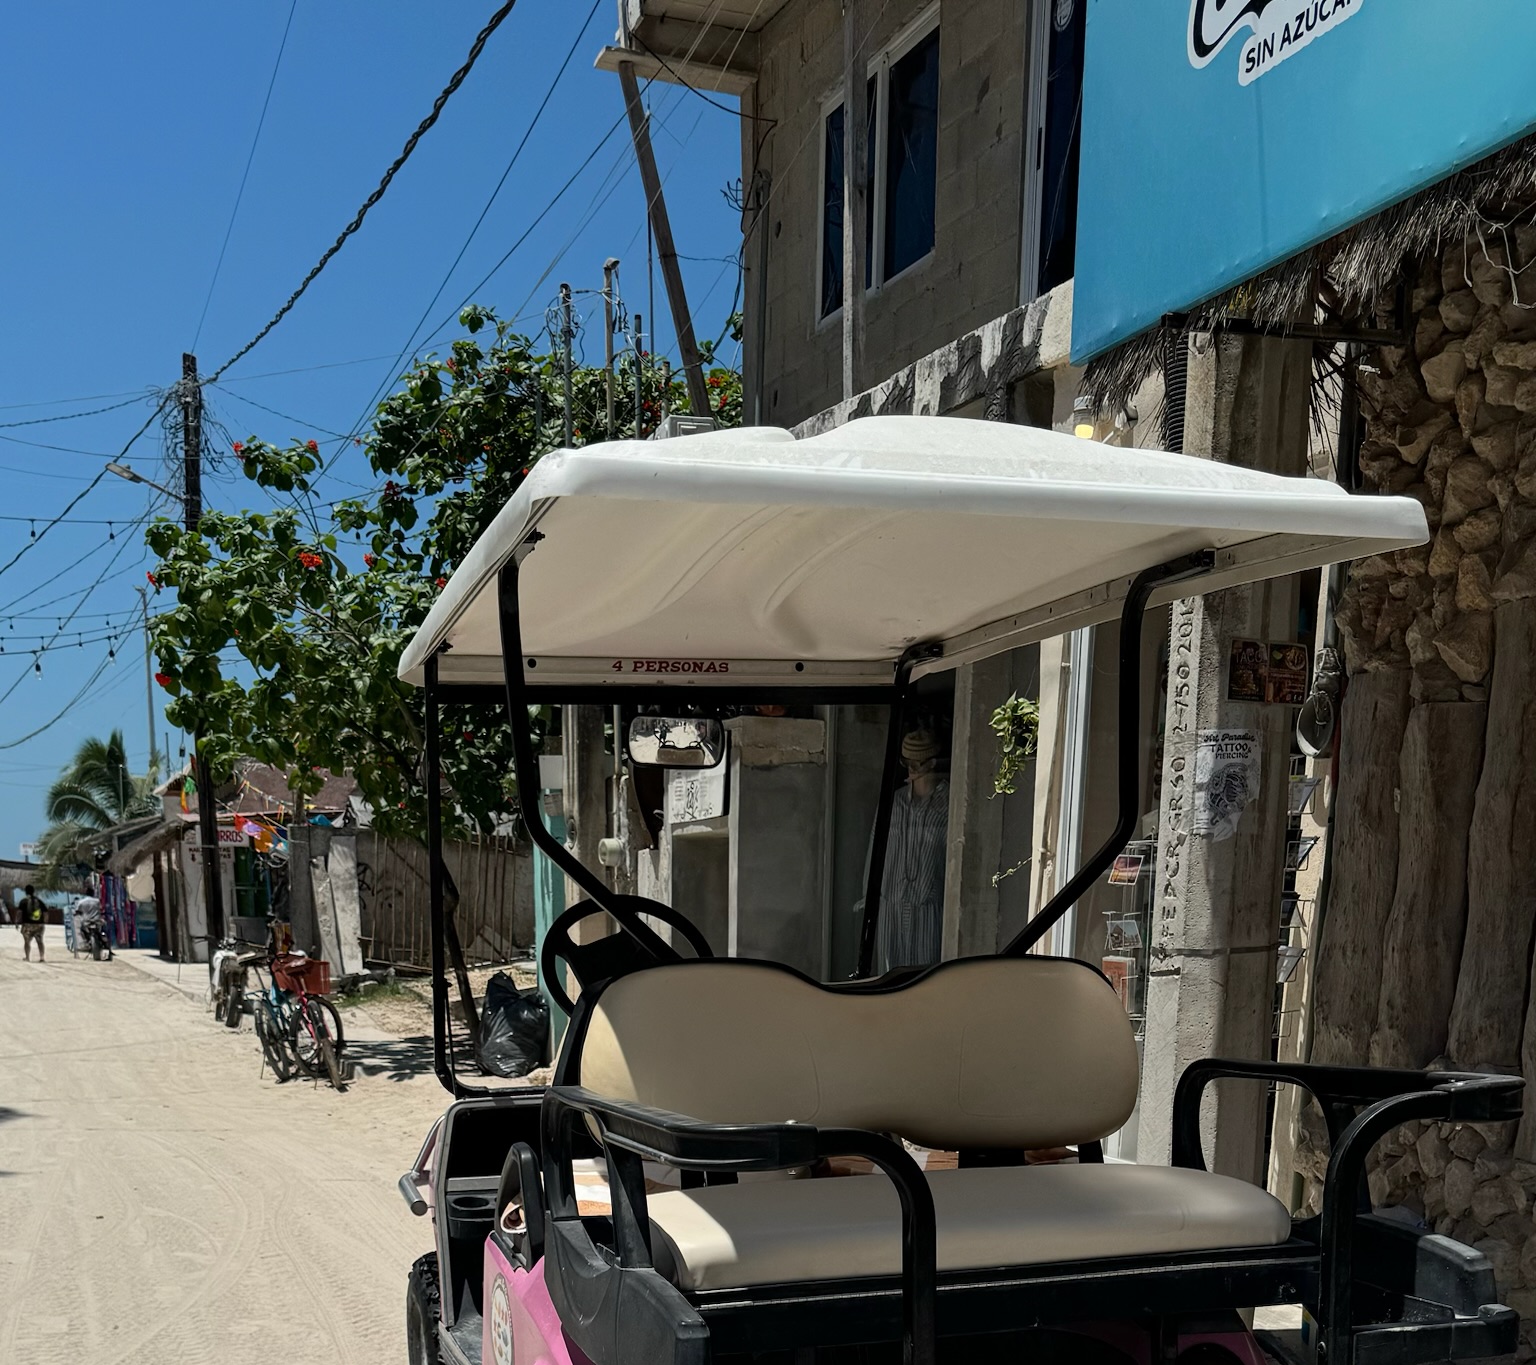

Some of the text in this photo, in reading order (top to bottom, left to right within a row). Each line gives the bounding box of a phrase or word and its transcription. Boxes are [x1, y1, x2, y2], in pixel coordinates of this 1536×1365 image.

[1245, 32, 1275, 74] SIN
[1279, 0, 1352, 52] AZÚCA
[612, 660, 729, 673] 4 PERSONAS
[1211, 743, 1248, 752] TATTOO
